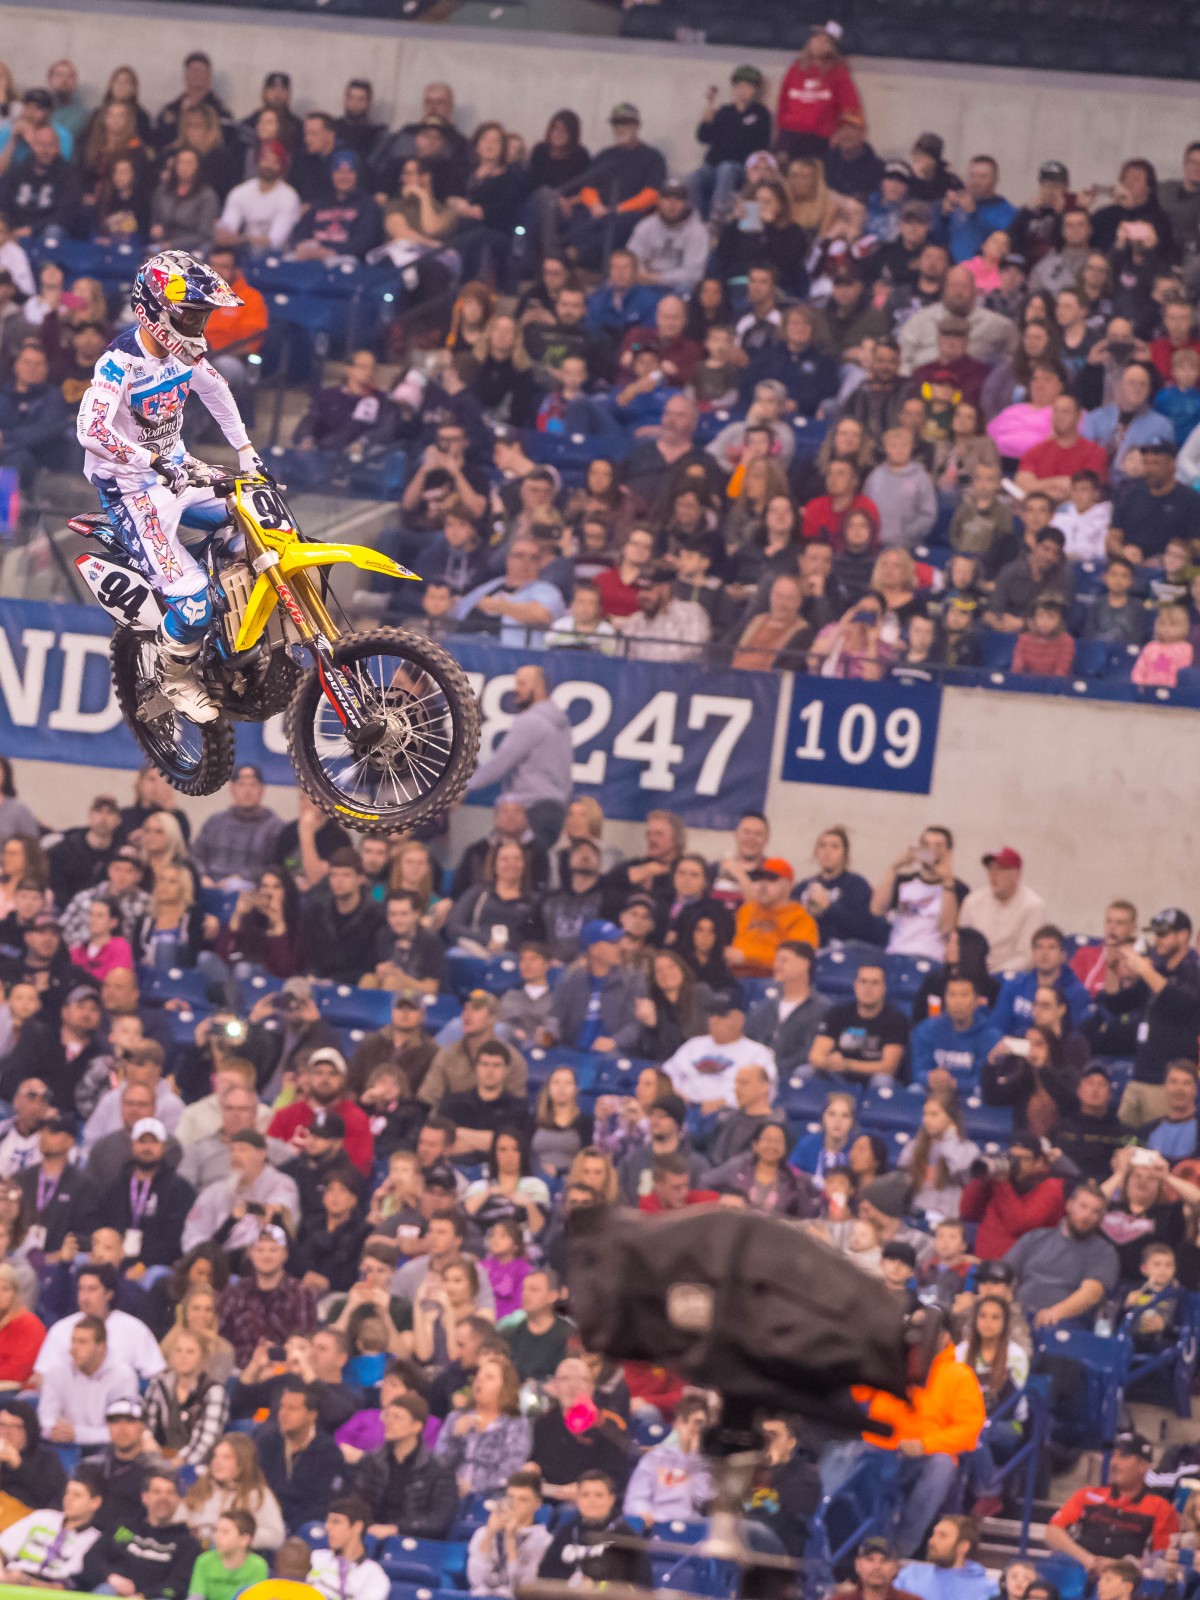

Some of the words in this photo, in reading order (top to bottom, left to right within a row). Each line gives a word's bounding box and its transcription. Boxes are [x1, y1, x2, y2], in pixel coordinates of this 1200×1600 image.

[252, 490, 294, 529] 94
[98, 571, 150, 620] 94
[324, 671, 362, 729] DUNLOP
[796, 700, 922, 768] 109
